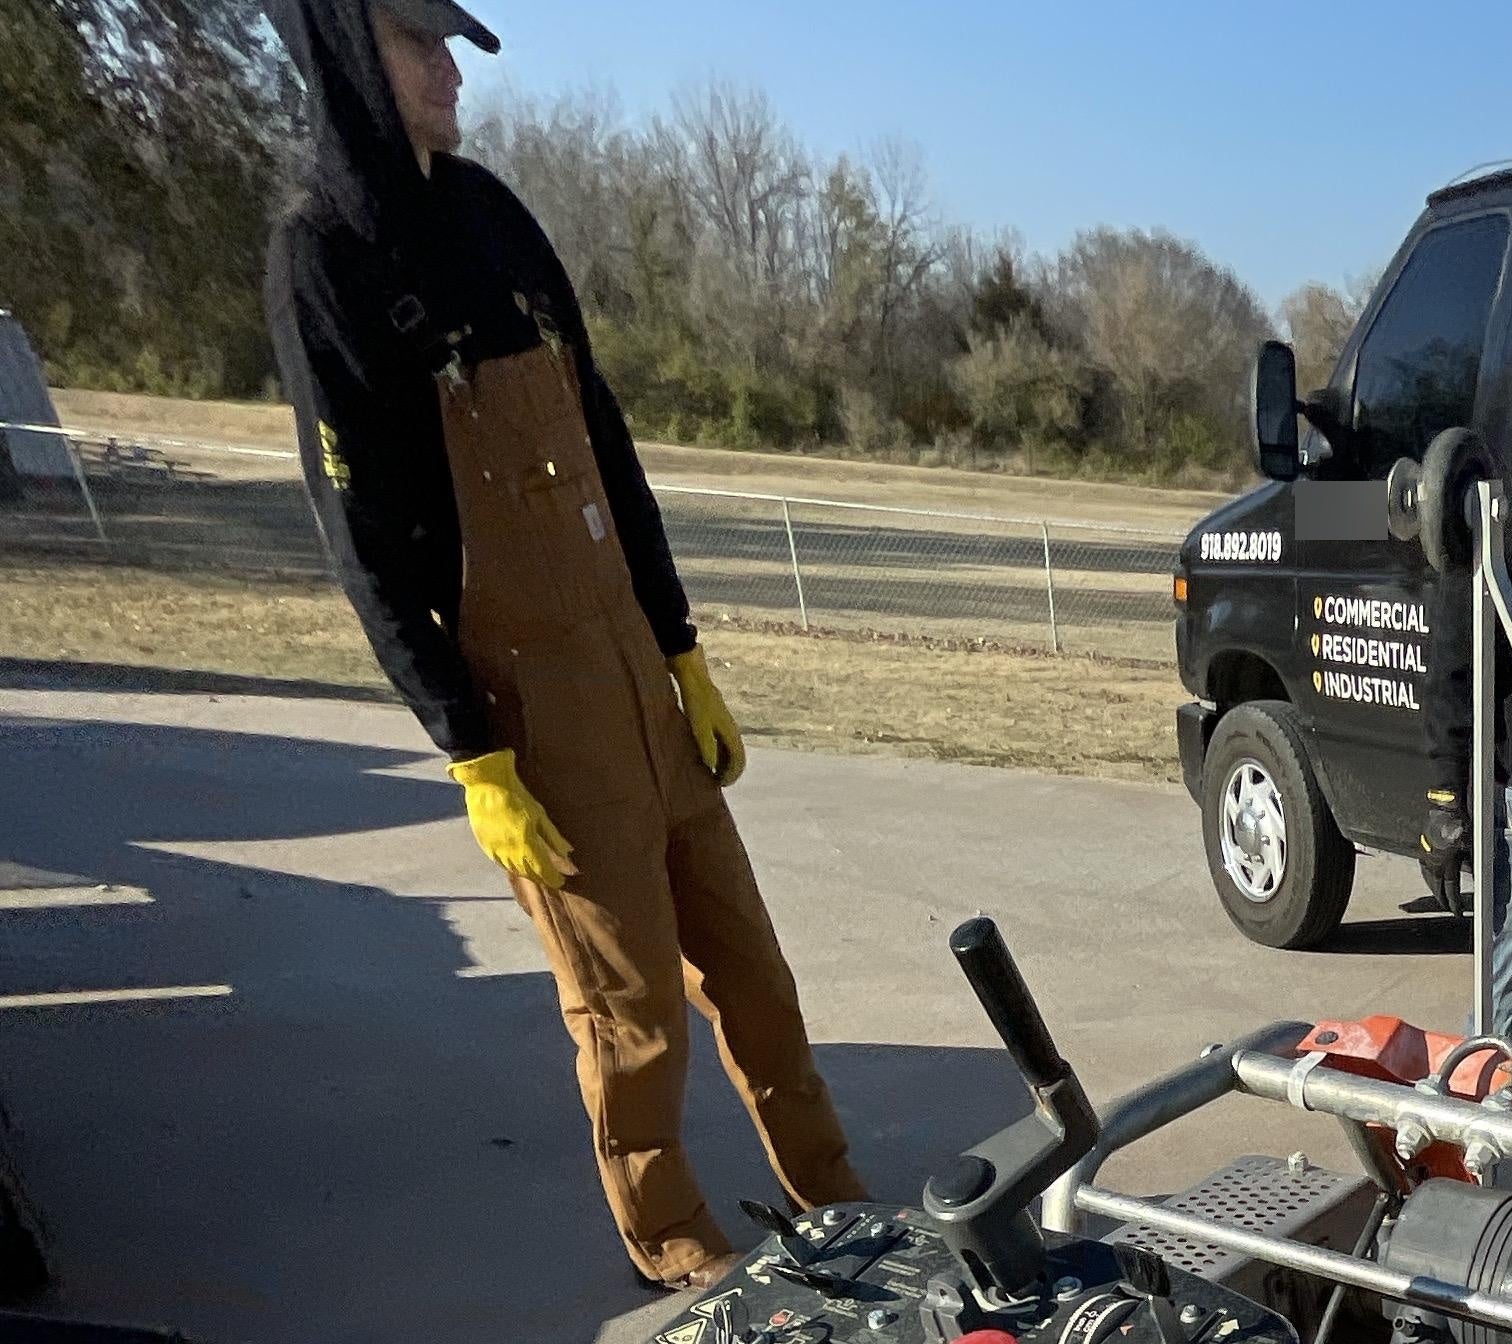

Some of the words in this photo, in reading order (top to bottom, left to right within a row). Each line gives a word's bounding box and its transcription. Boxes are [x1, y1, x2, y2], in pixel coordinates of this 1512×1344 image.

[1201, 531, 1281, 561] 918.892.8019
[1325, 596, 1430, 633] COMMERCIAL
[1322, 634, 1427, 673] RESIDENTIAL
[1324, 671, 1420, 710] INDUSTRIAL
